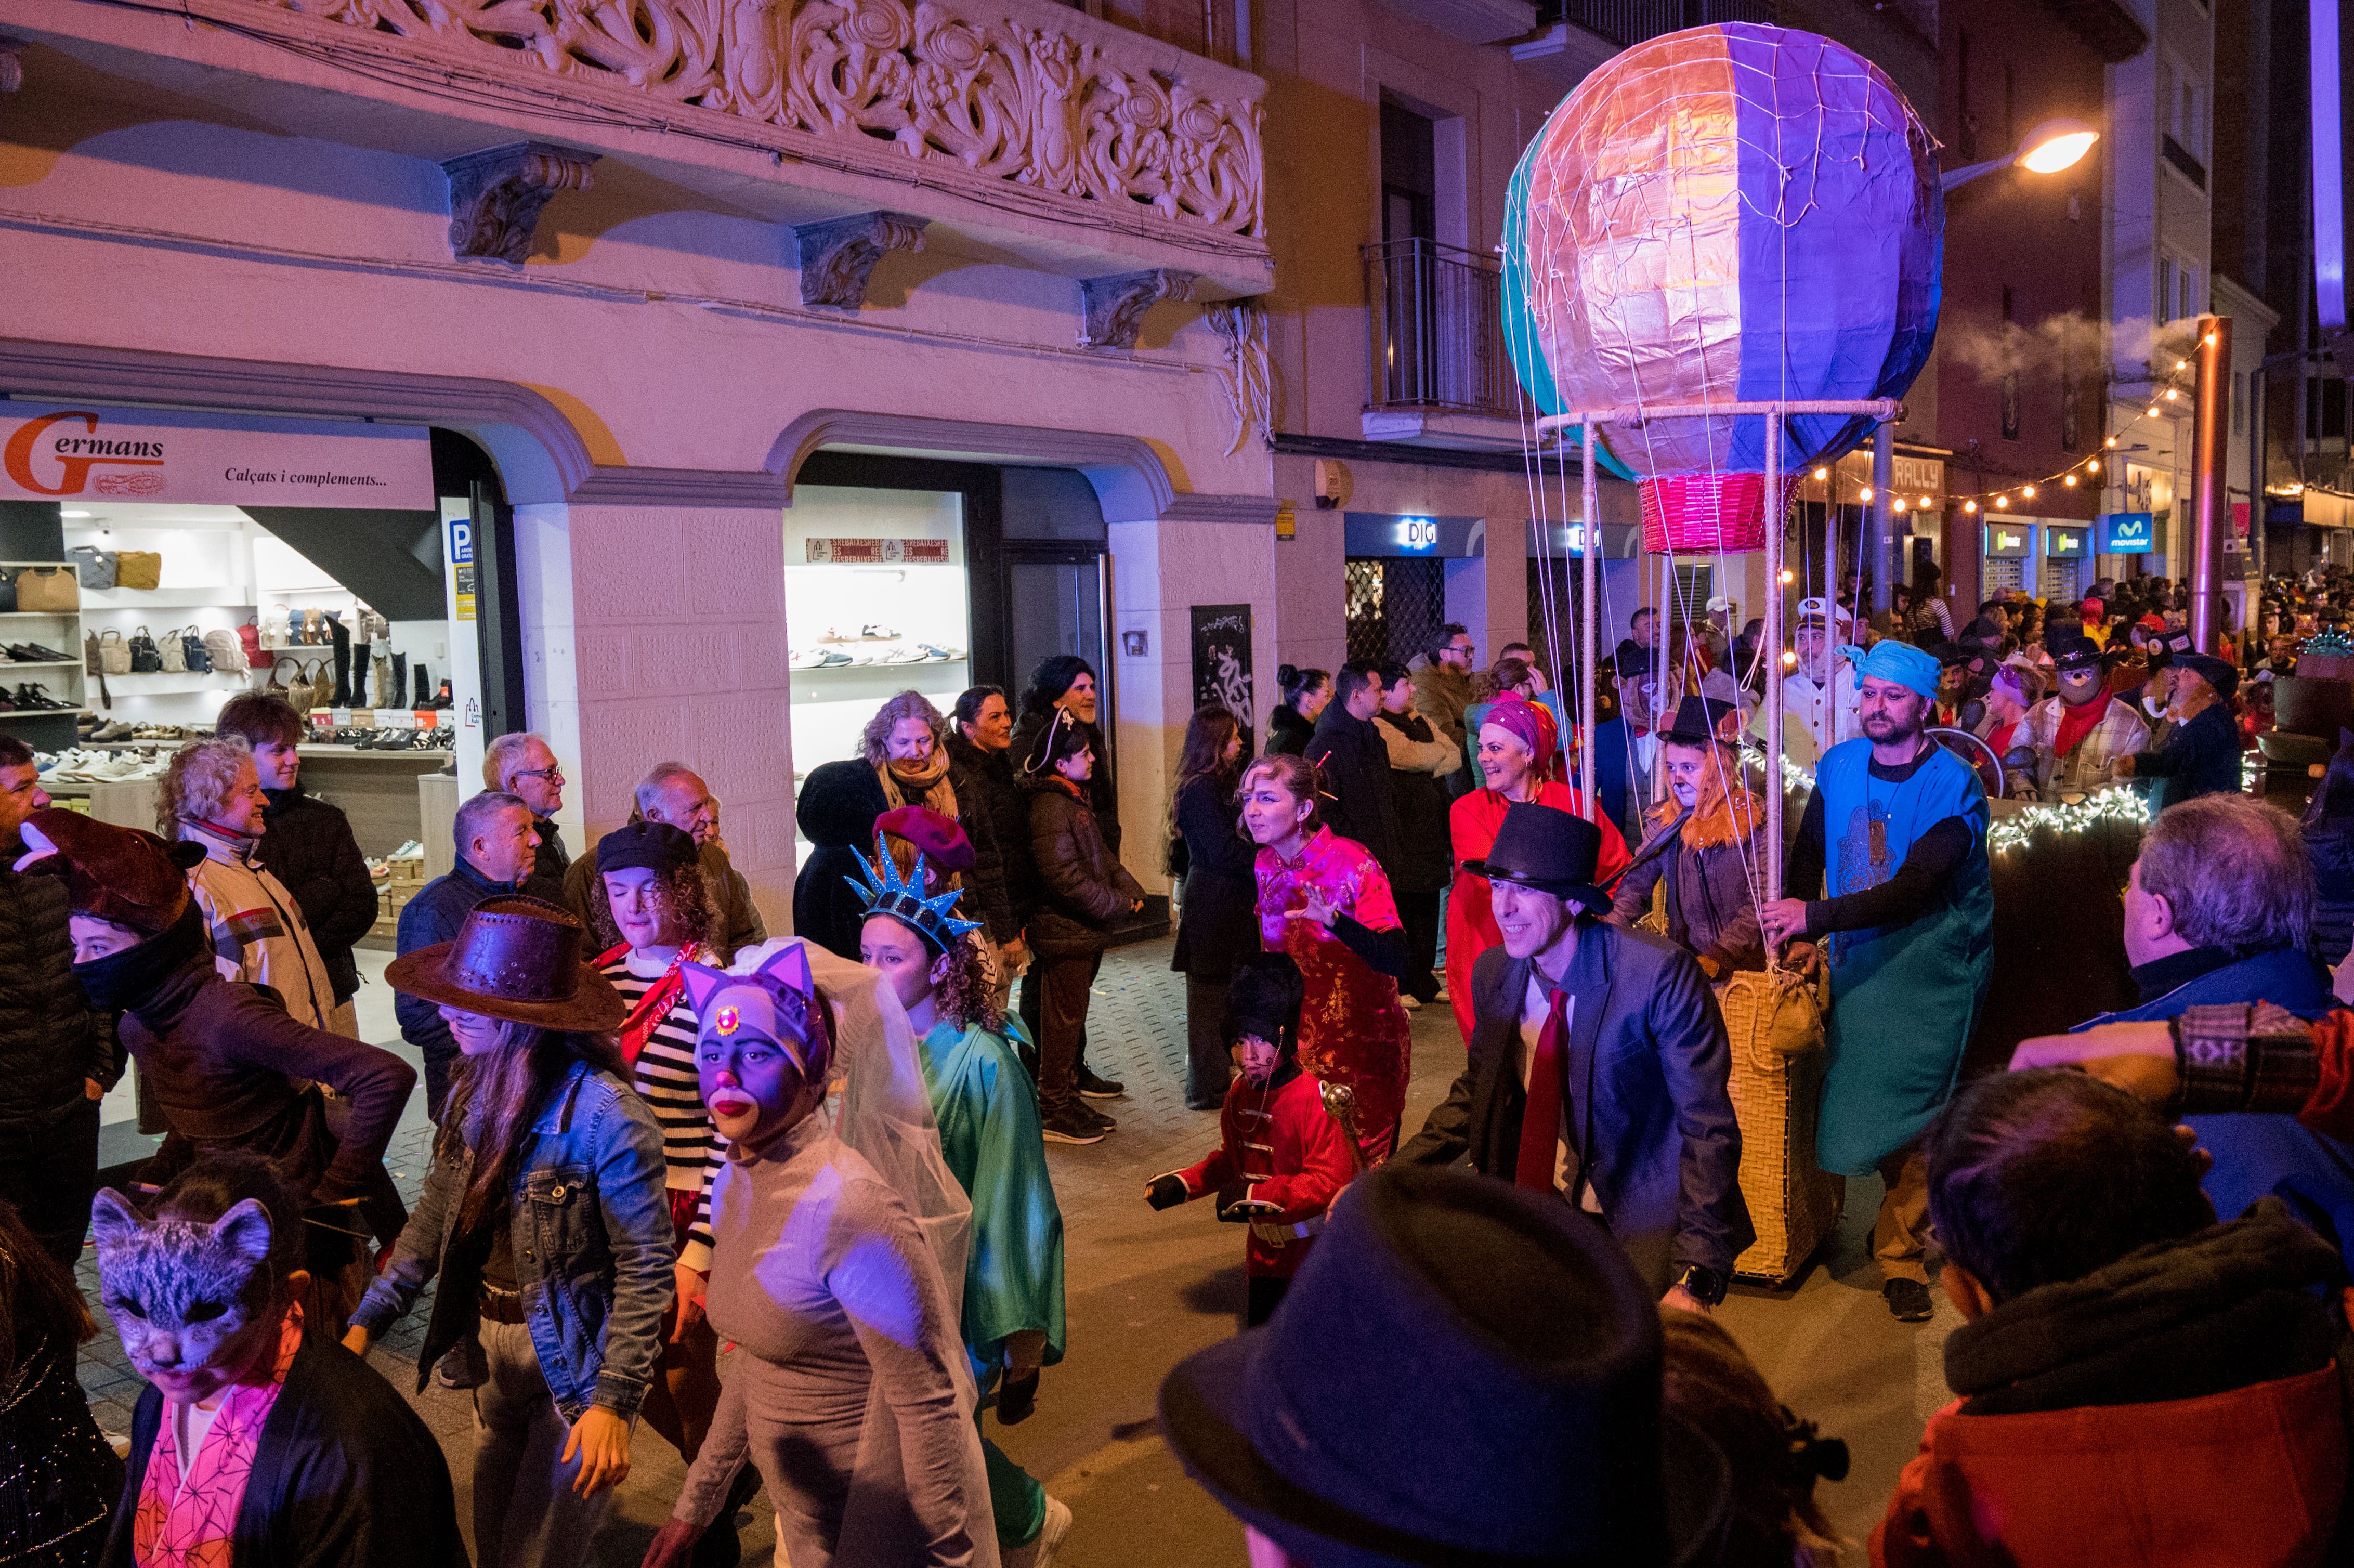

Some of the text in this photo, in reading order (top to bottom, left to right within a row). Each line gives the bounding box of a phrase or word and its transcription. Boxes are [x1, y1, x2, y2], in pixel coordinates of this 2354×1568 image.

[4, 411, 164, 495] Germans
[225, 468, 387, 487] Calçats i complements...
[1895, 461, 1938, 489] RALLY
[2111, 538, 2149, 546] movistar
